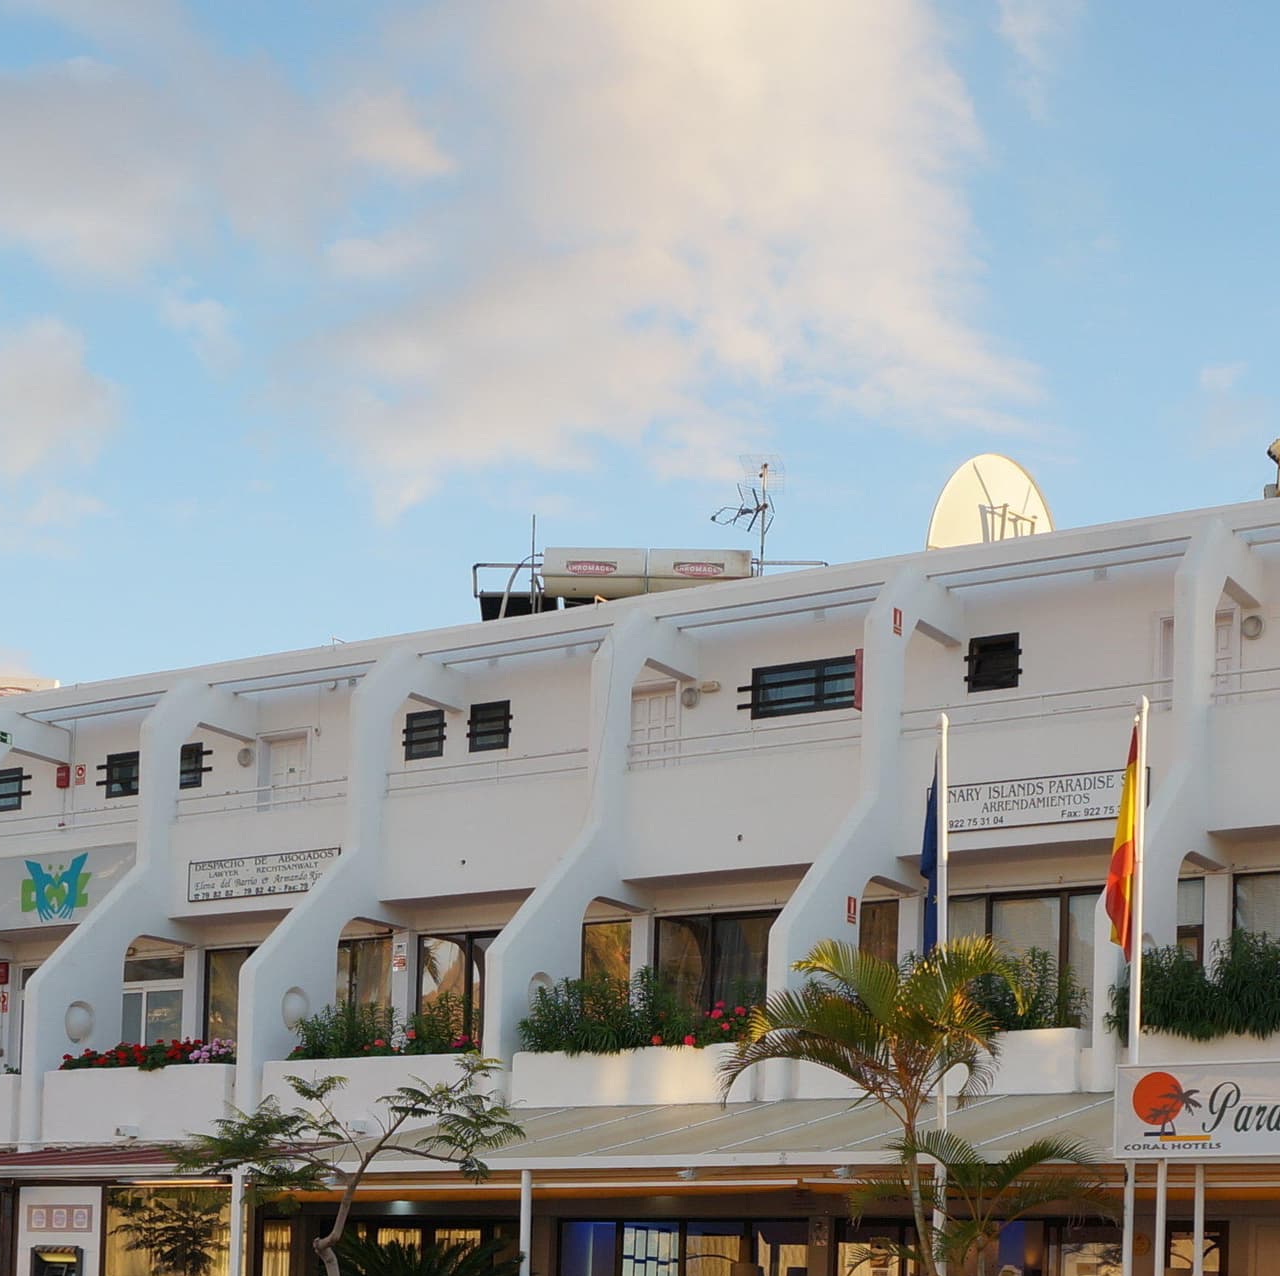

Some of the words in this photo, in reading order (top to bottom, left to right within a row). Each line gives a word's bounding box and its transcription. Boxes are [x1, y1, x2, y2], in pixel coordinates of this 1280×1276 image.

[948, 787, 982, 804] NARY
[988, 780, 1044, 800] ISLANDS
[1048, 774, 1115, 796] PARADISE
[981, 792, 1091, 814] ARRENDAMIENTOS
[949, 820, 965, 828] 922
[967, 818, 978, 826] 75
[980, 817, 990, 825] 31
[993, 815, 1004, 824] 04
[1061, 808, 1081, 819] Fax:
[1083, 806, 1101, 817] 922
[1103, 805, 1115, 815] 75
[194, 859, 245, 872] DESPACHO
[278, 849, 335, 863] ABOGADOS
[1124, 1143, 1168, 1152] CORAL
[1171, 1142, 1222, 1150] HOTELS
